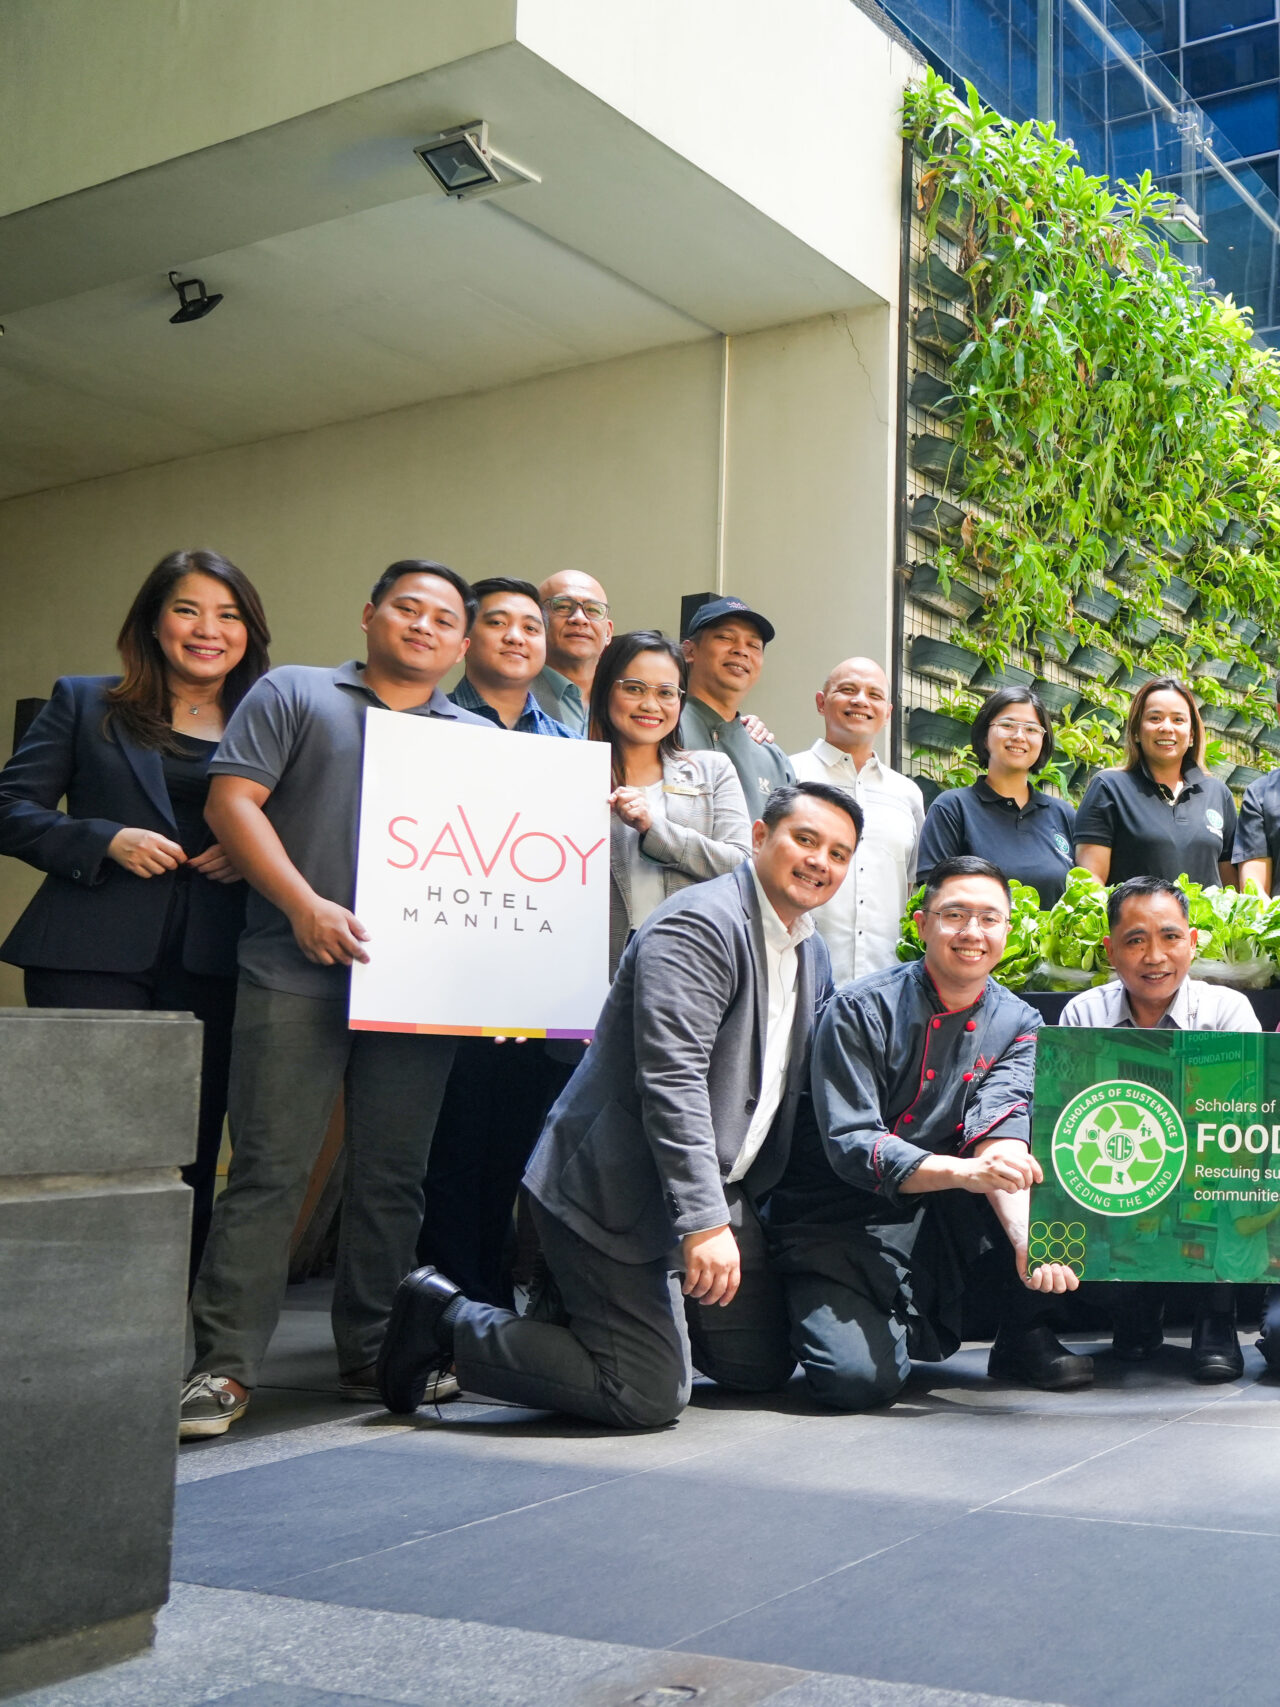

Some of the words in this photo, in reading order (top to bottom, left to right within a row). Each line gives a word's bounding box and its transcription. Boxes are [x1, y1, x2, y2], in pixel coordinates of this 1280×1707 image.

[386, 804, 607, 886] SAVOY
[427, 885, 538, 911] HOTEL
[403, 907, 553, 933] MANILA
[1188, 1050, 1241, 1065] FOUNDATION
[1063, 1091, 1105, 1135] SCHOLARS
[1108, 1088, 1122, 1097] OF
[1125, 1089, 1178, 1139] SUSTENANCE
[1195, 1098, 1257, 1113] Scholars
[1261, 1100, 1276, 1113] of
[1194, 1164, 1260, 1182] Rescuing
[1065, 1170, 1111, 1208] FEEDING
[1118, 1195, 1143, 1208] THE
[1146, 1170, 1172, 1198] MIND
